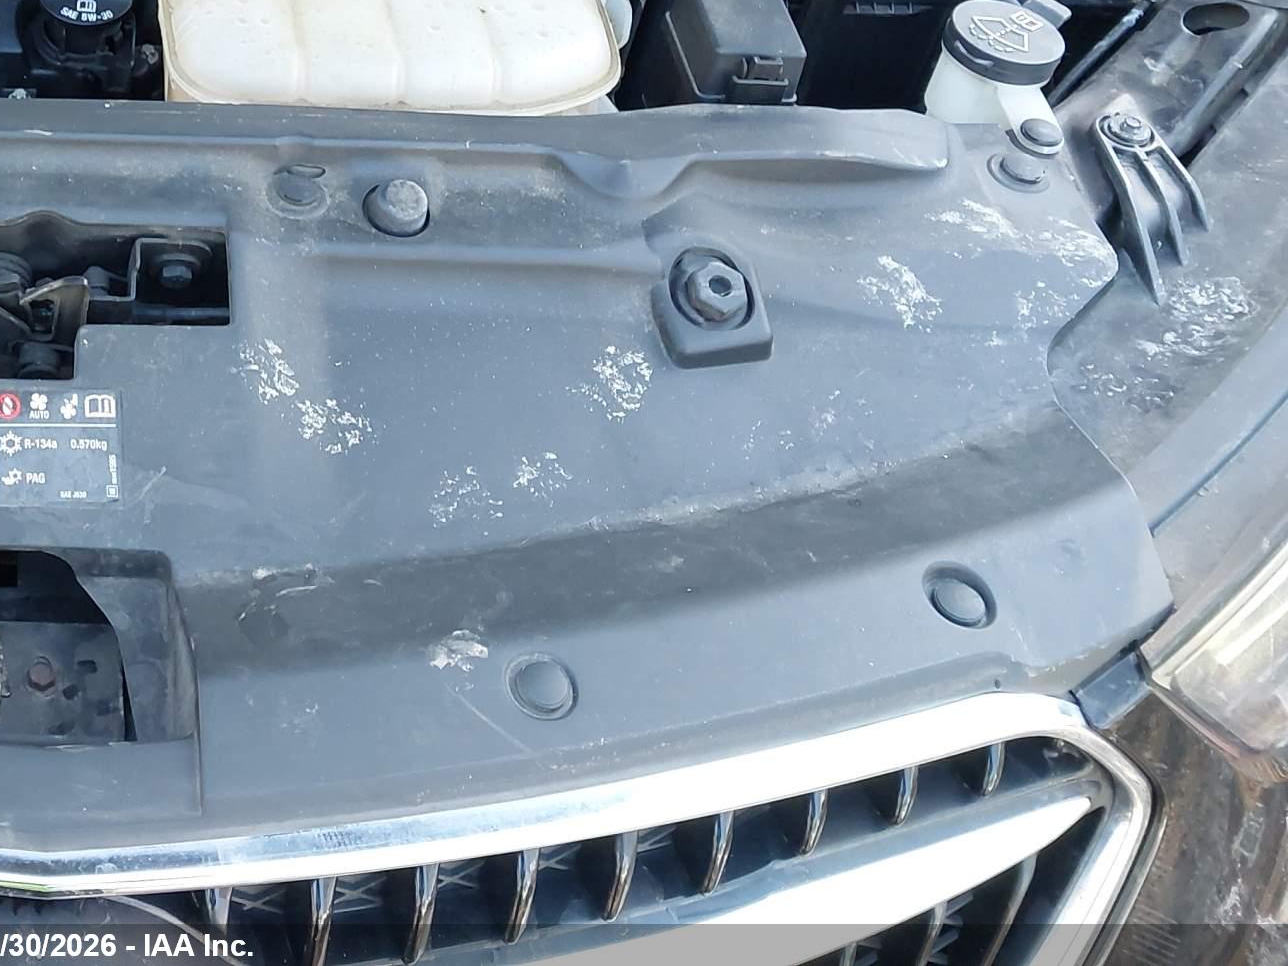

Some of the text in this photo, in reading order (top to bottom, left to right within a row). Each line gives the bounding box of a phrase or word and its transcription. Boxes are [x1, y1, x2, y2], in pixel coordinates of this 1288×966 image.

[60, 6, 79, 21] SAE
[29, 410, 50, 420] AUTO
[24, 438, 108, 451] R-134a 0.570kg
[25, 472, 46, 484] PAG
